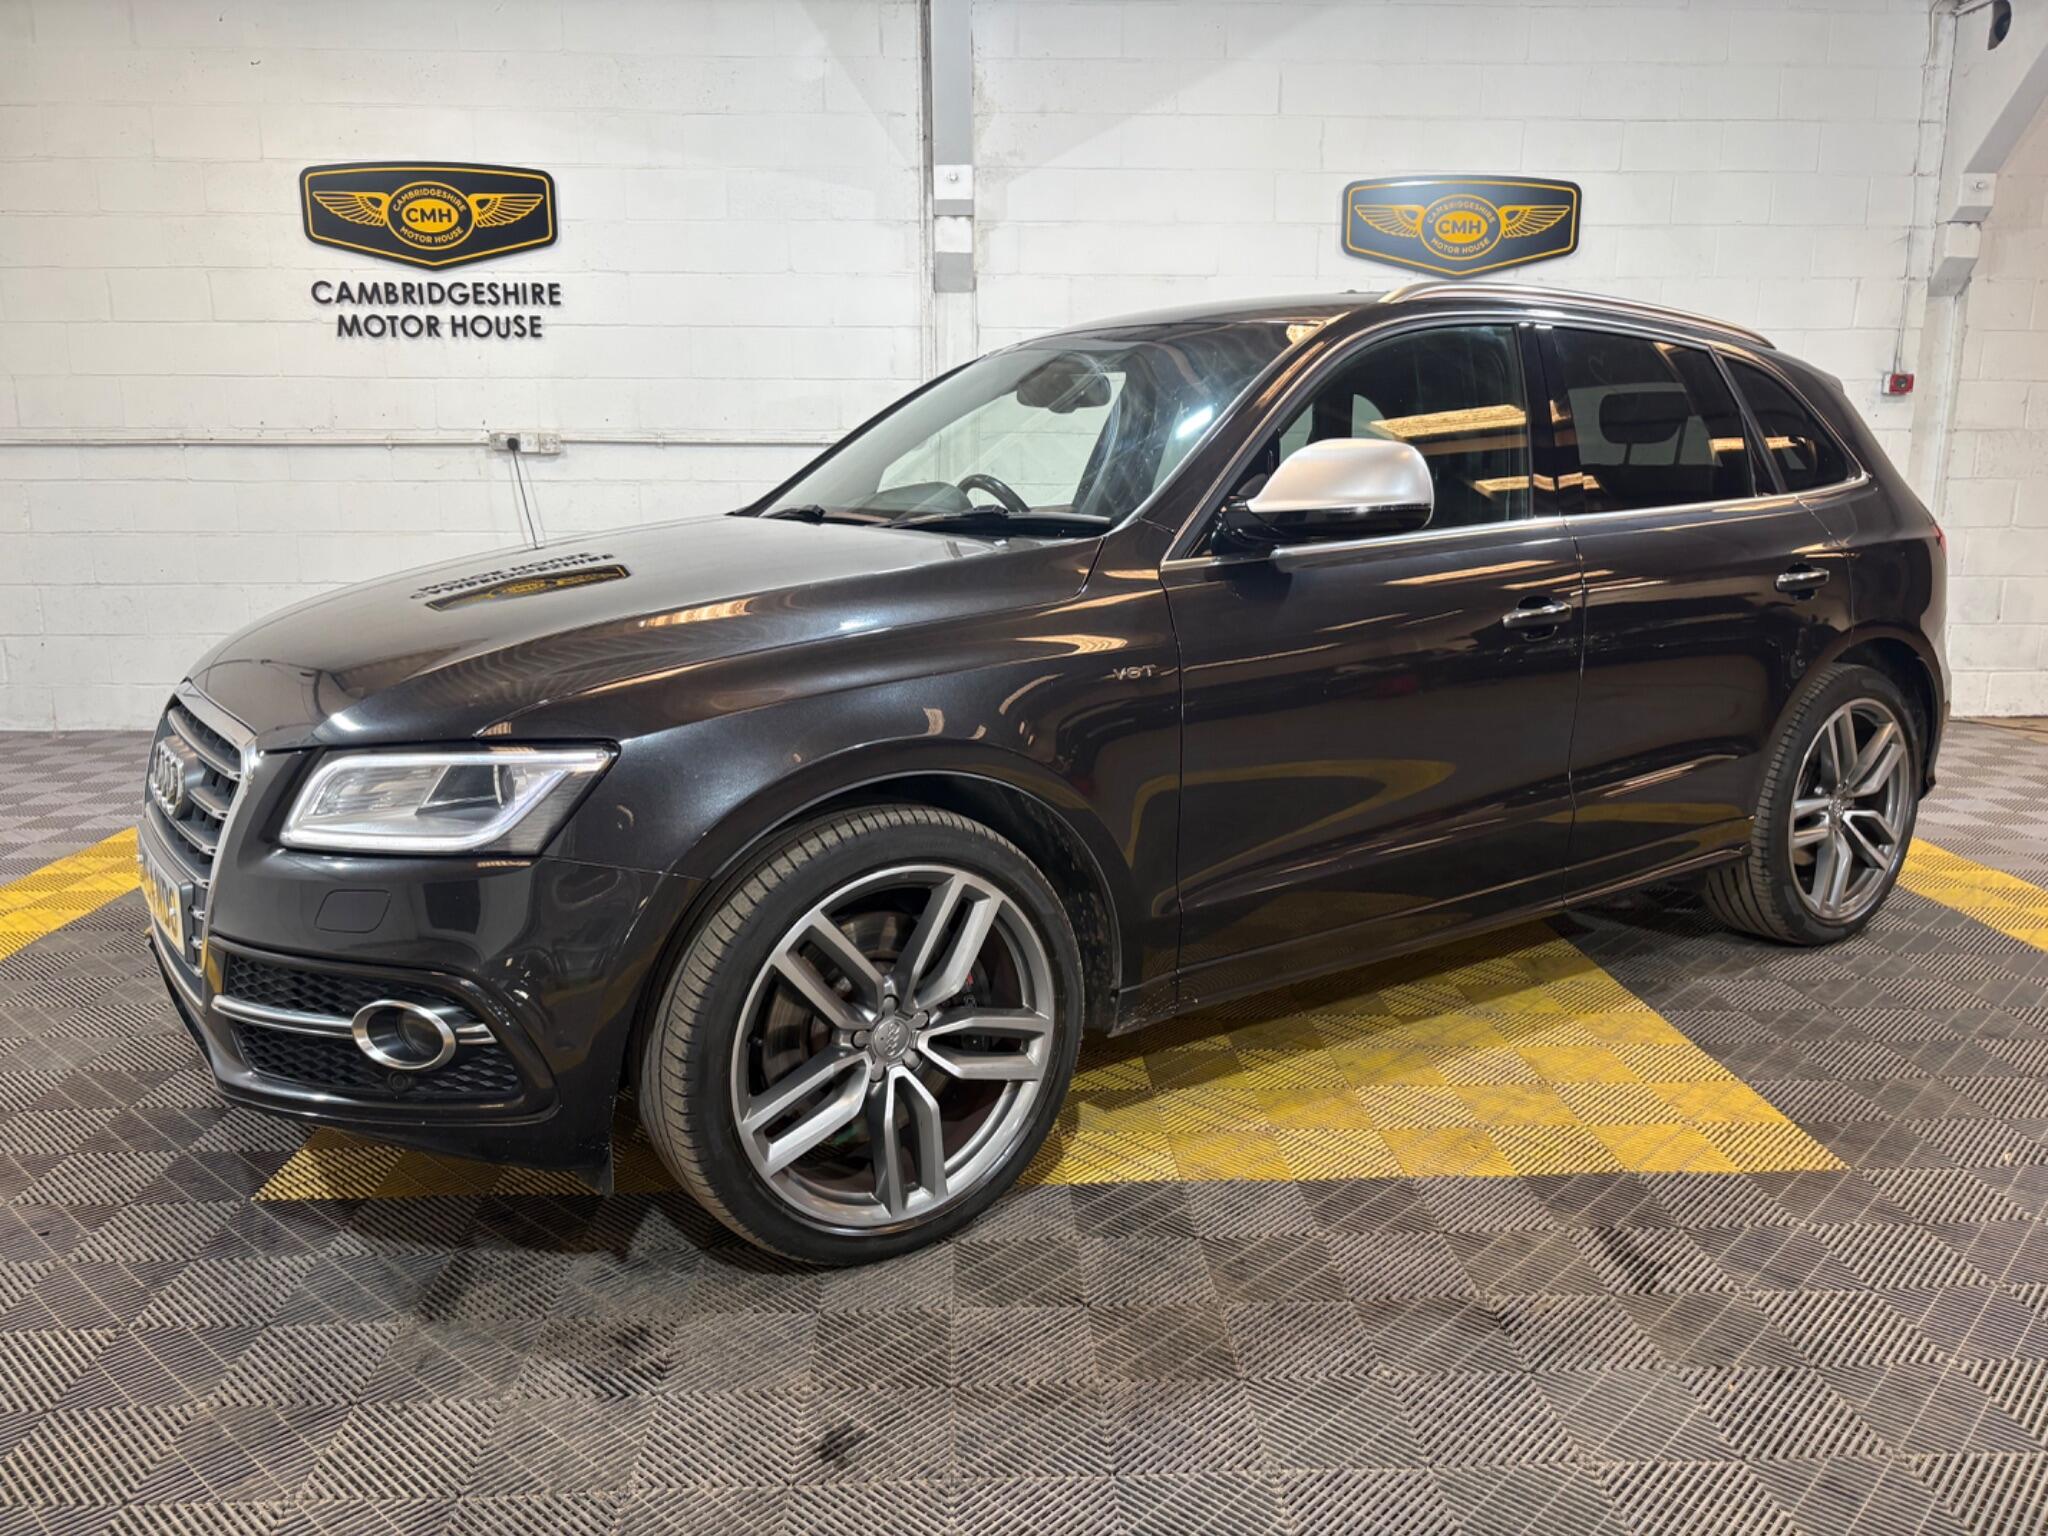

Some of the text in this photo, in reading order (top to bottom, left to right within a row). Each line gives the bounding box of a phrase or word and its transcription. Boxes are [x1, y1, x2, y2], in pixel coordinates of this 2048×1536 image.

[393, 188, 467, 212] CAMBRIDGESHIRE
[406, 207, 452, 223] CMH
[1427, 201, 1496, 224] CAMBRIDGESHIRE
[400, 226, 464, 243] MOTOR HOUSE
[1438, 219, 1482, 235] CMH
[1431, 238, 1490, 254] MOTOR HOUSE
[311, 280, 562, 306] CAMBRIDGESHIRE
[337, 314, 543, 338] MOTOR HOUSE
